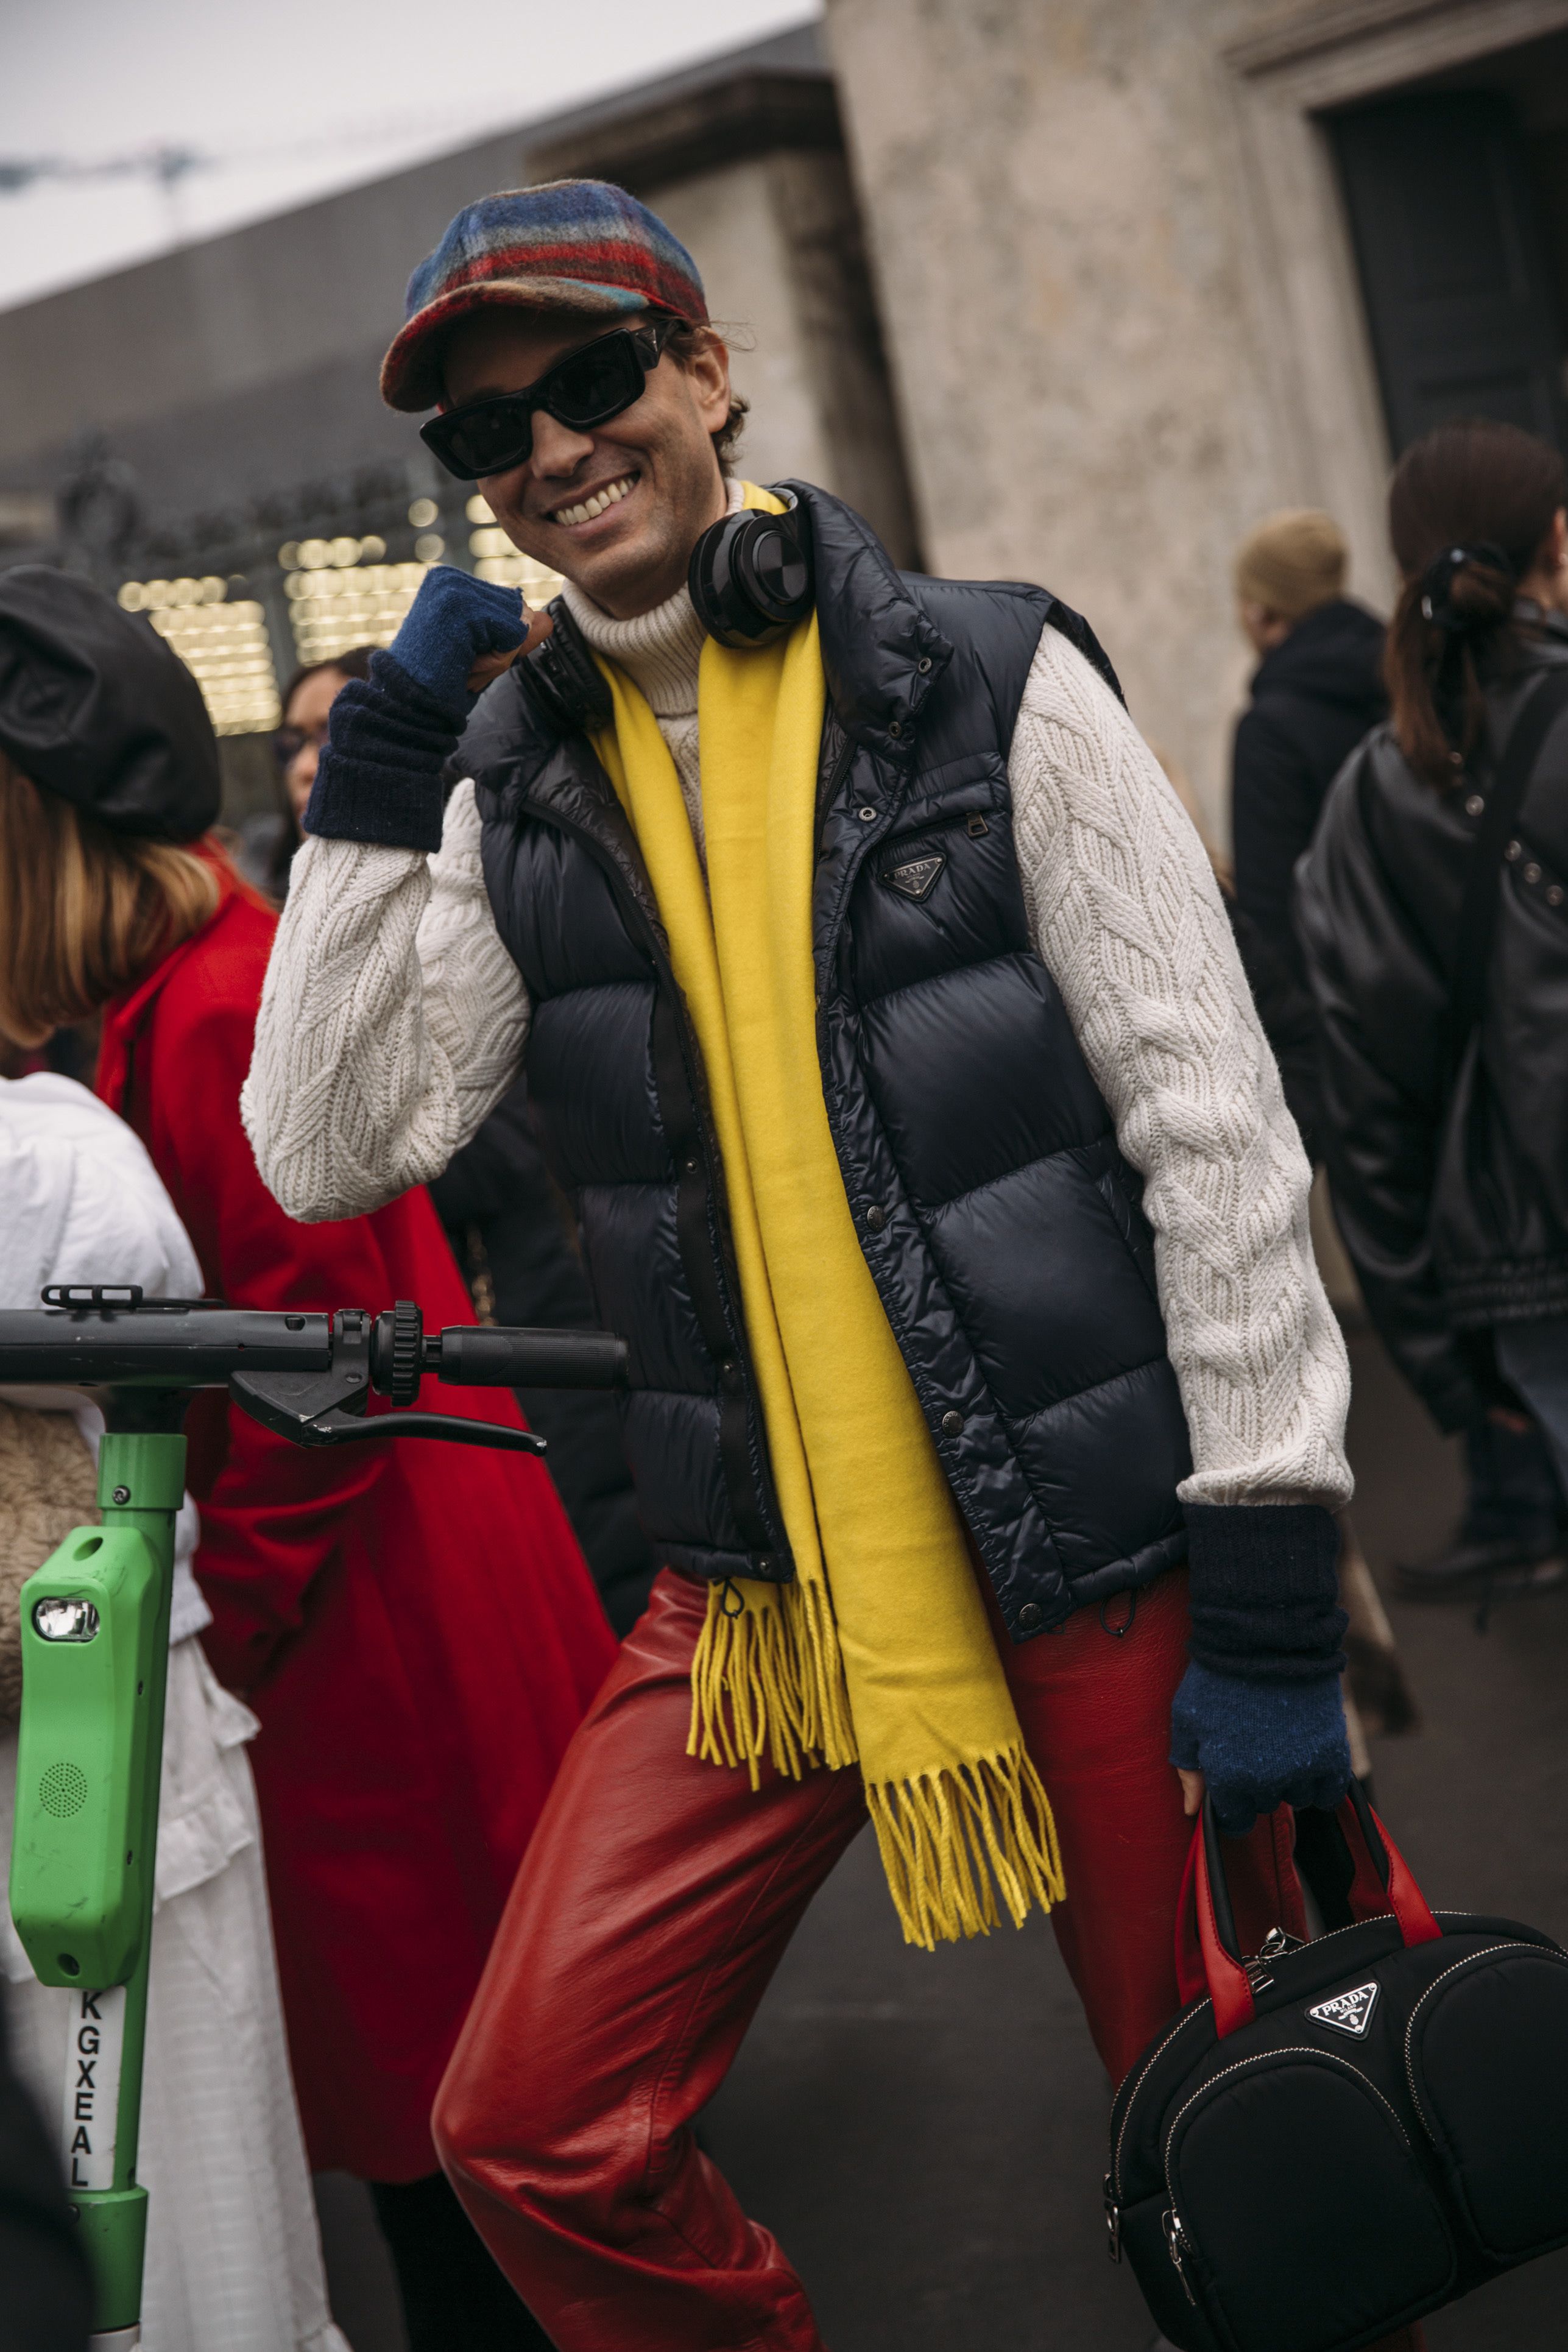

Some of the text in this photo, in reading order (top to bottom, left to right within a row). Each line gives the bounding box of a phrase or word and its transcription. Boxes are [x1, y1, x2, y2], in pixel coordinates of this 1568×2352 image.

[894, 863, 931, 879] PRADA
[1322, 1991, 1369, 2016] PRADA
[71, 1991, 102, 2188] KGXEAL
